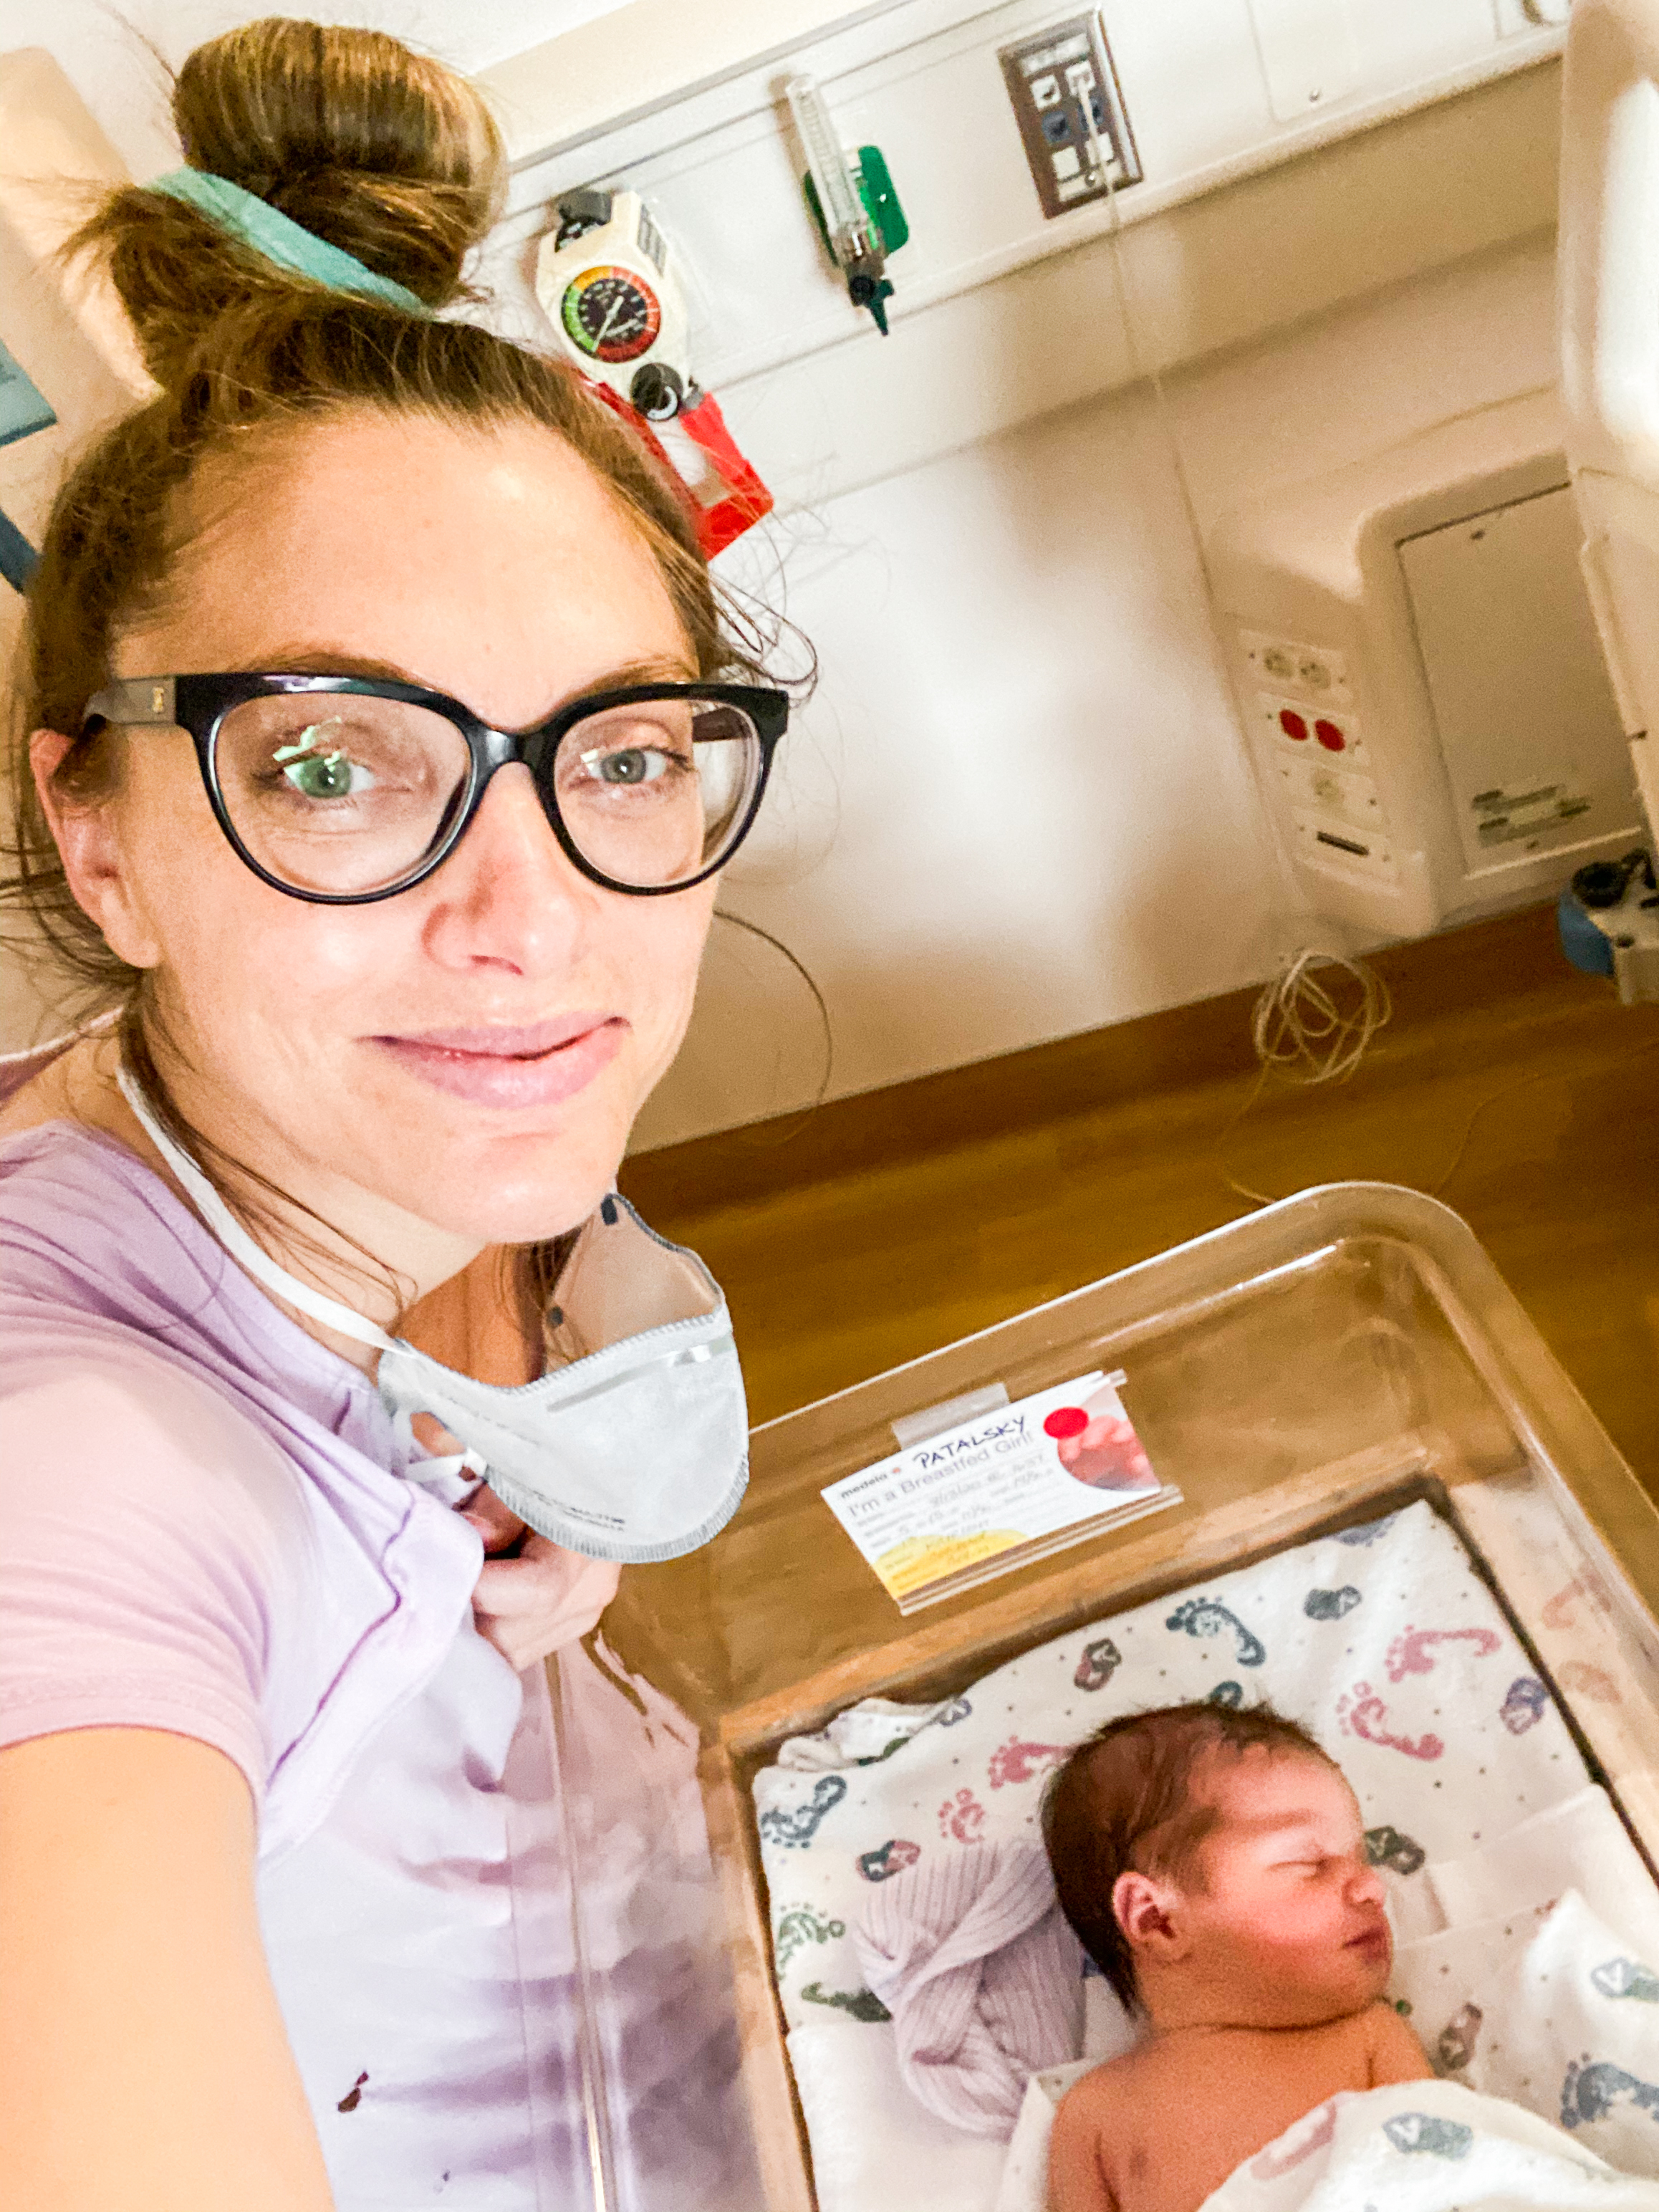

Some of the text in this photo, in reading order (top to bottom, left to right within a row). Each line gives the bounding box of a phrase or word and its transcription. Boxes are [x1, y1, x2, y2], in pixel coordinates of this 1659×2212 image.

[913, 1415, 1025, 1468] PATALSKY
[841, 1473, 888, 1499] medela
[849, 1498, 880, 1517] I'm
[885, 1490, 897, 1501] a
[900, 1448, 991, 1494] Breastfed
